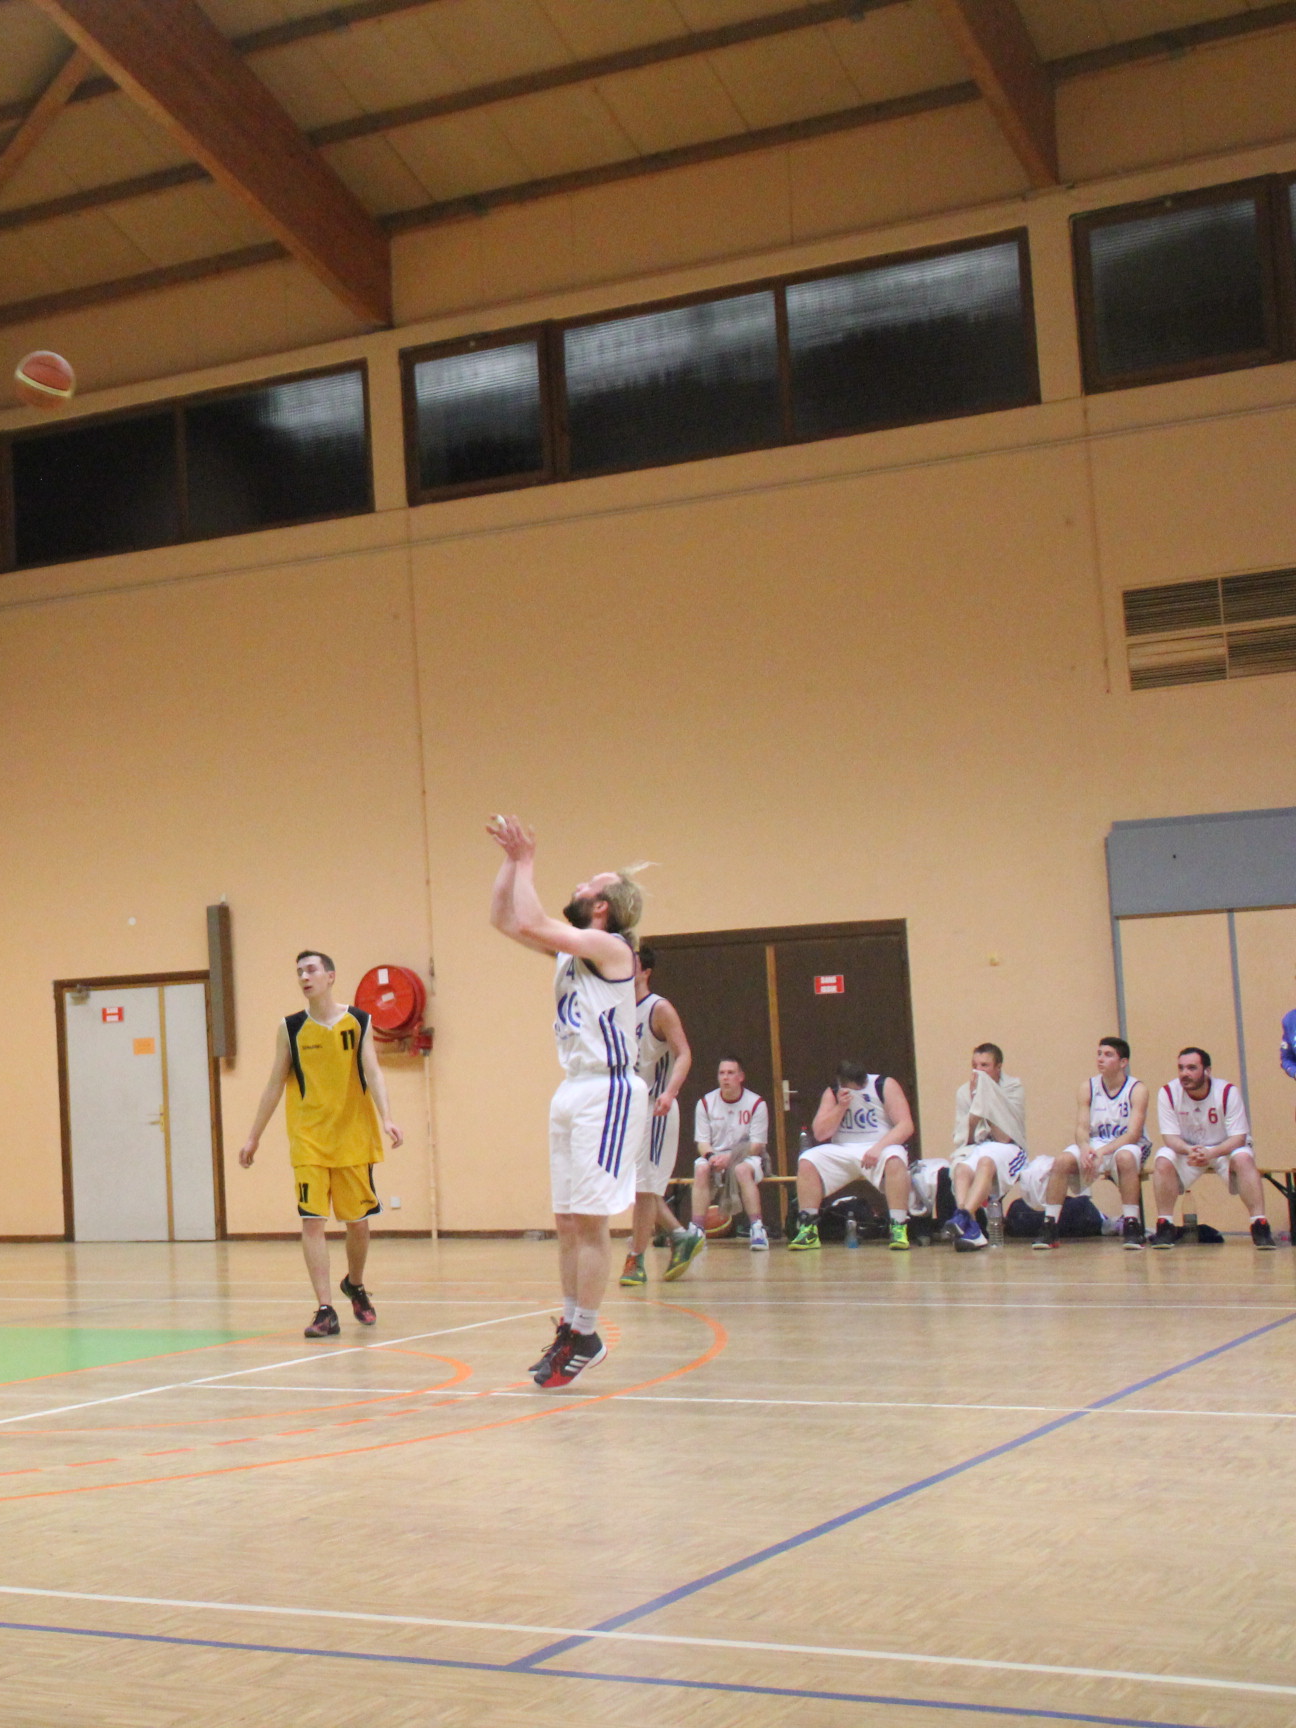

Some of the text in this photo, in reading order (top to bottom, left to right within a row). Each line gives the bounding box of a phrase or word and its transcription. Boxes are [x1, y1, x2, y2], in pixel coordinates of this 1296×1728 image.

[340, 1028, 355, 1051] 11
[738, 1110, 751, 1125] 10
[1208, 1107, 1219, 1124] 6
